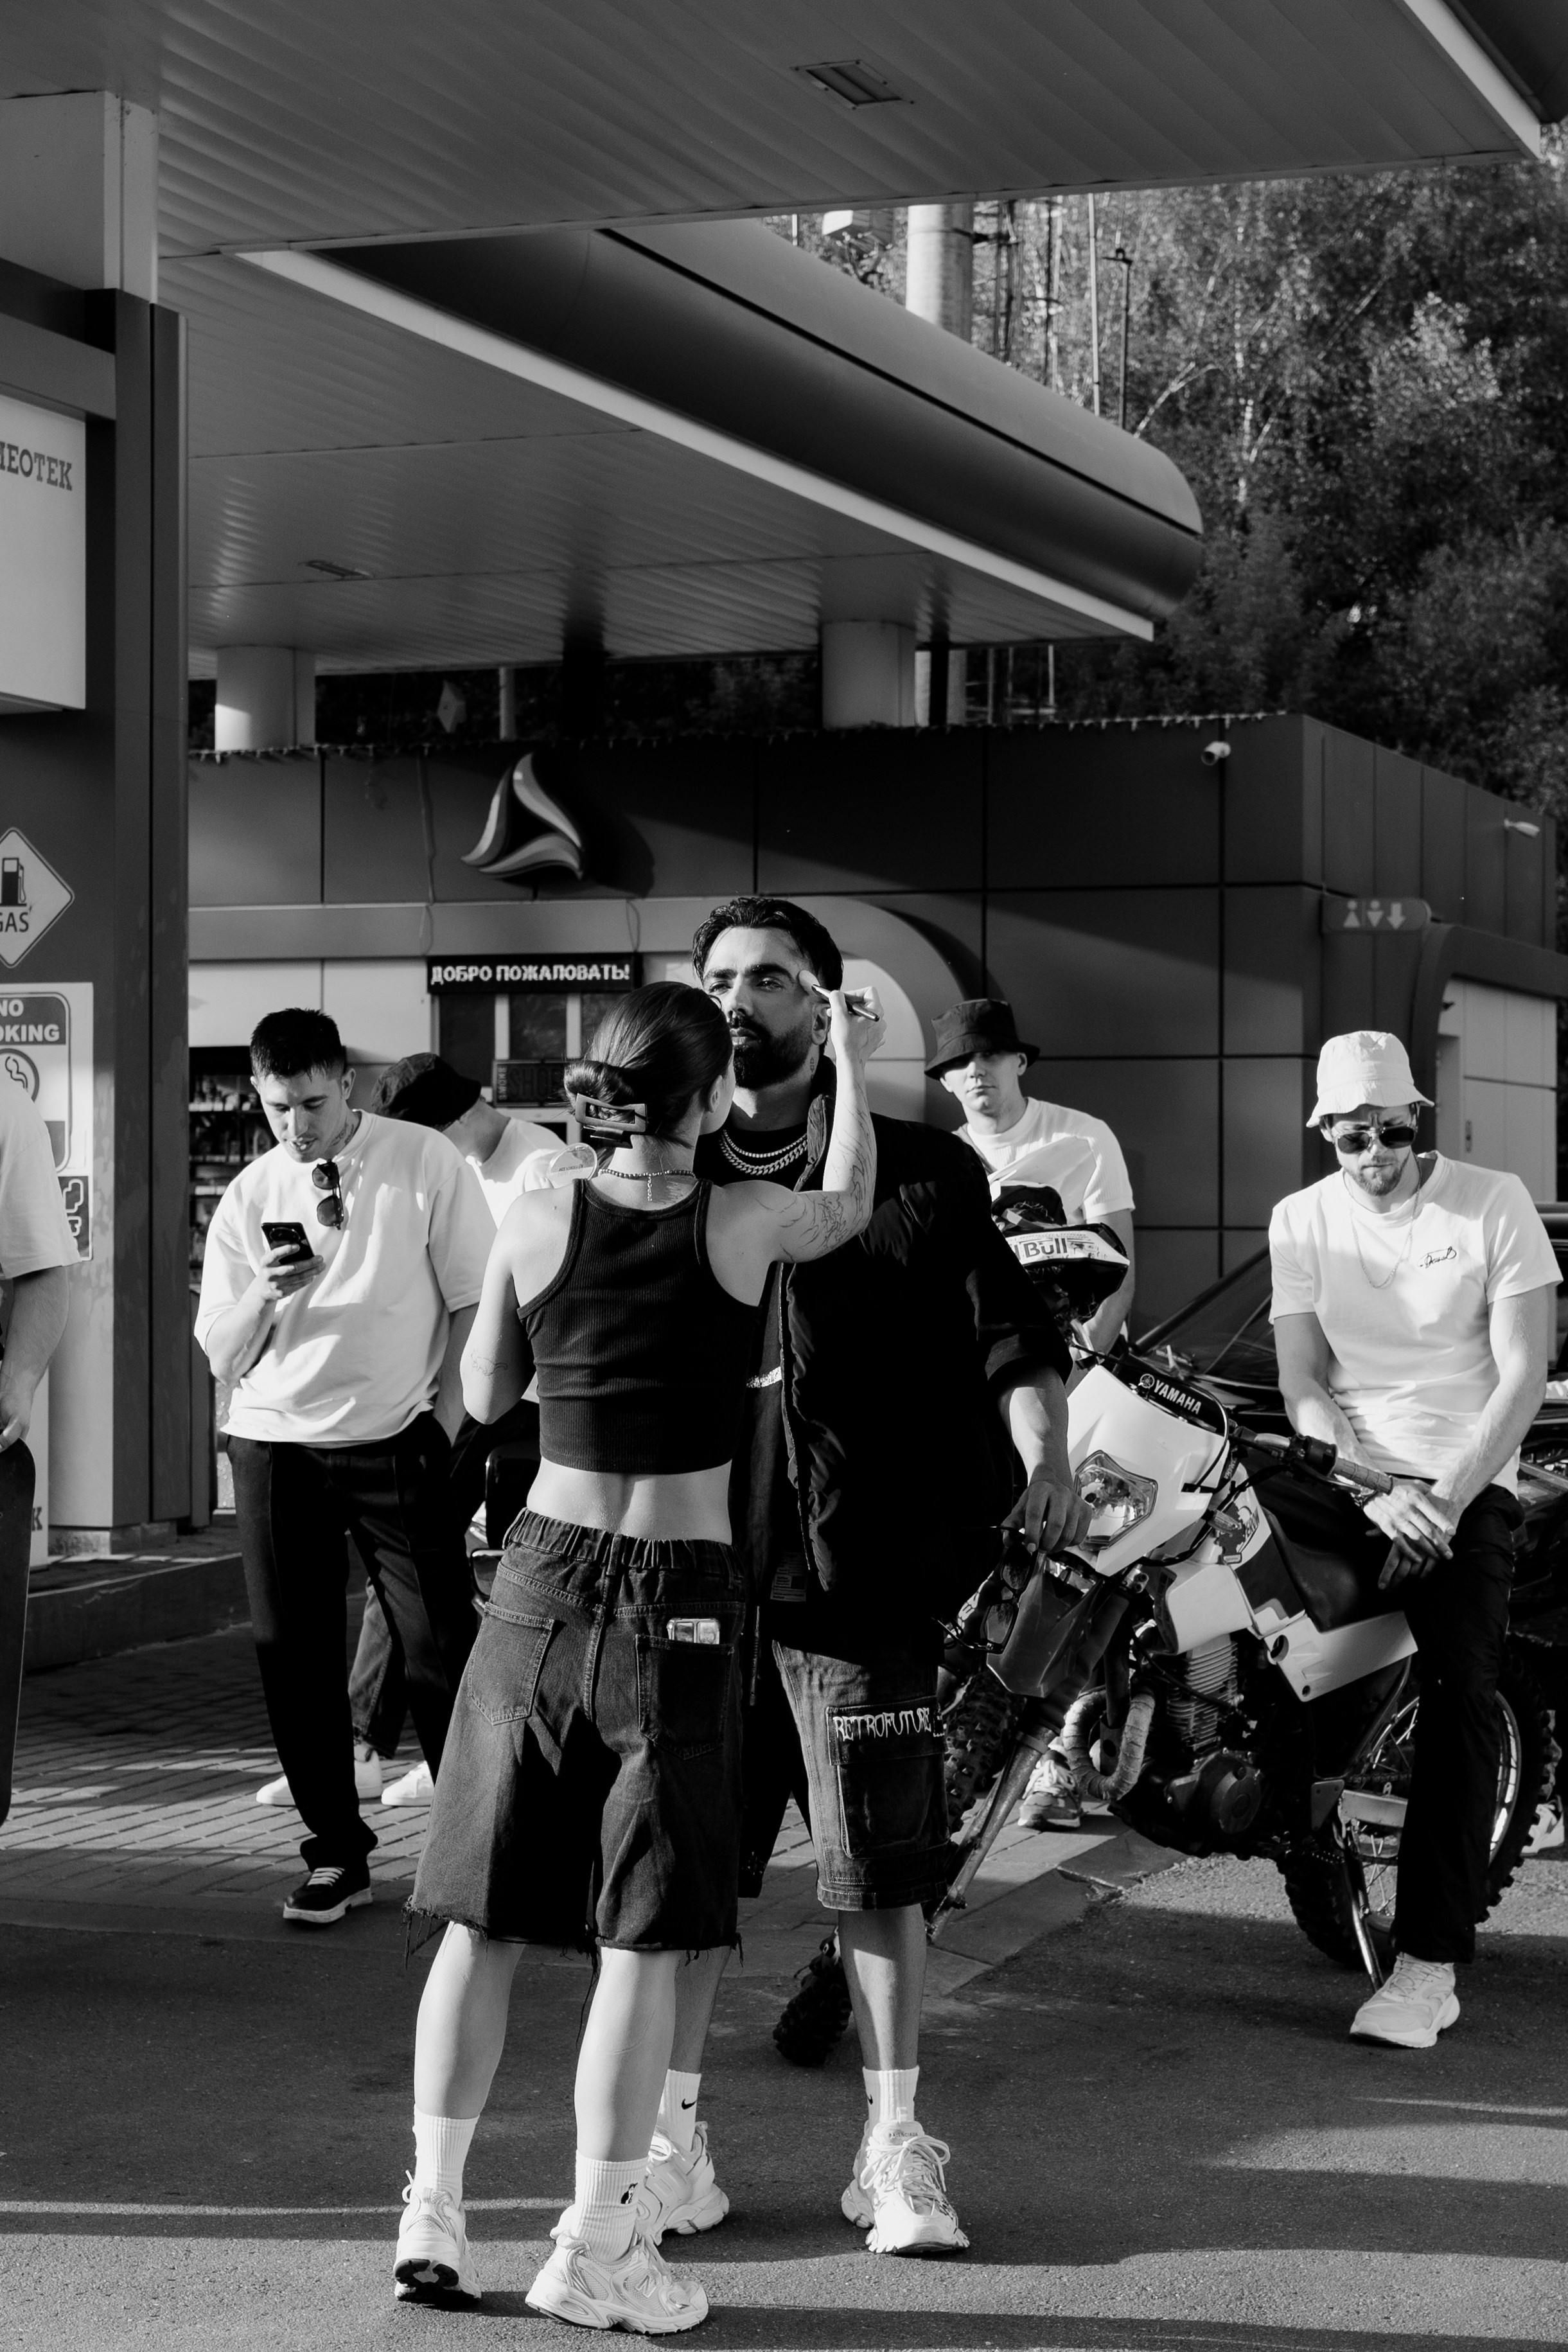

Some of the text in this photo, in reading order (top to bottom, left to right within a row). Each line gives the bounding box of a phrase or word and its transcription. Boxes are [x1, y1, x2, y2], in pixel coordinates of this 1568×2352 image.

[431, 964, 630, 986] ДОБРО ПОЖАЛОВАТЬ!
[1023, 1238, 1067, 1258] Bull
[1154, 1379, 1201, 1415] YAMAHA
[833, 1708, 931, 1742] RETROFUTURE
